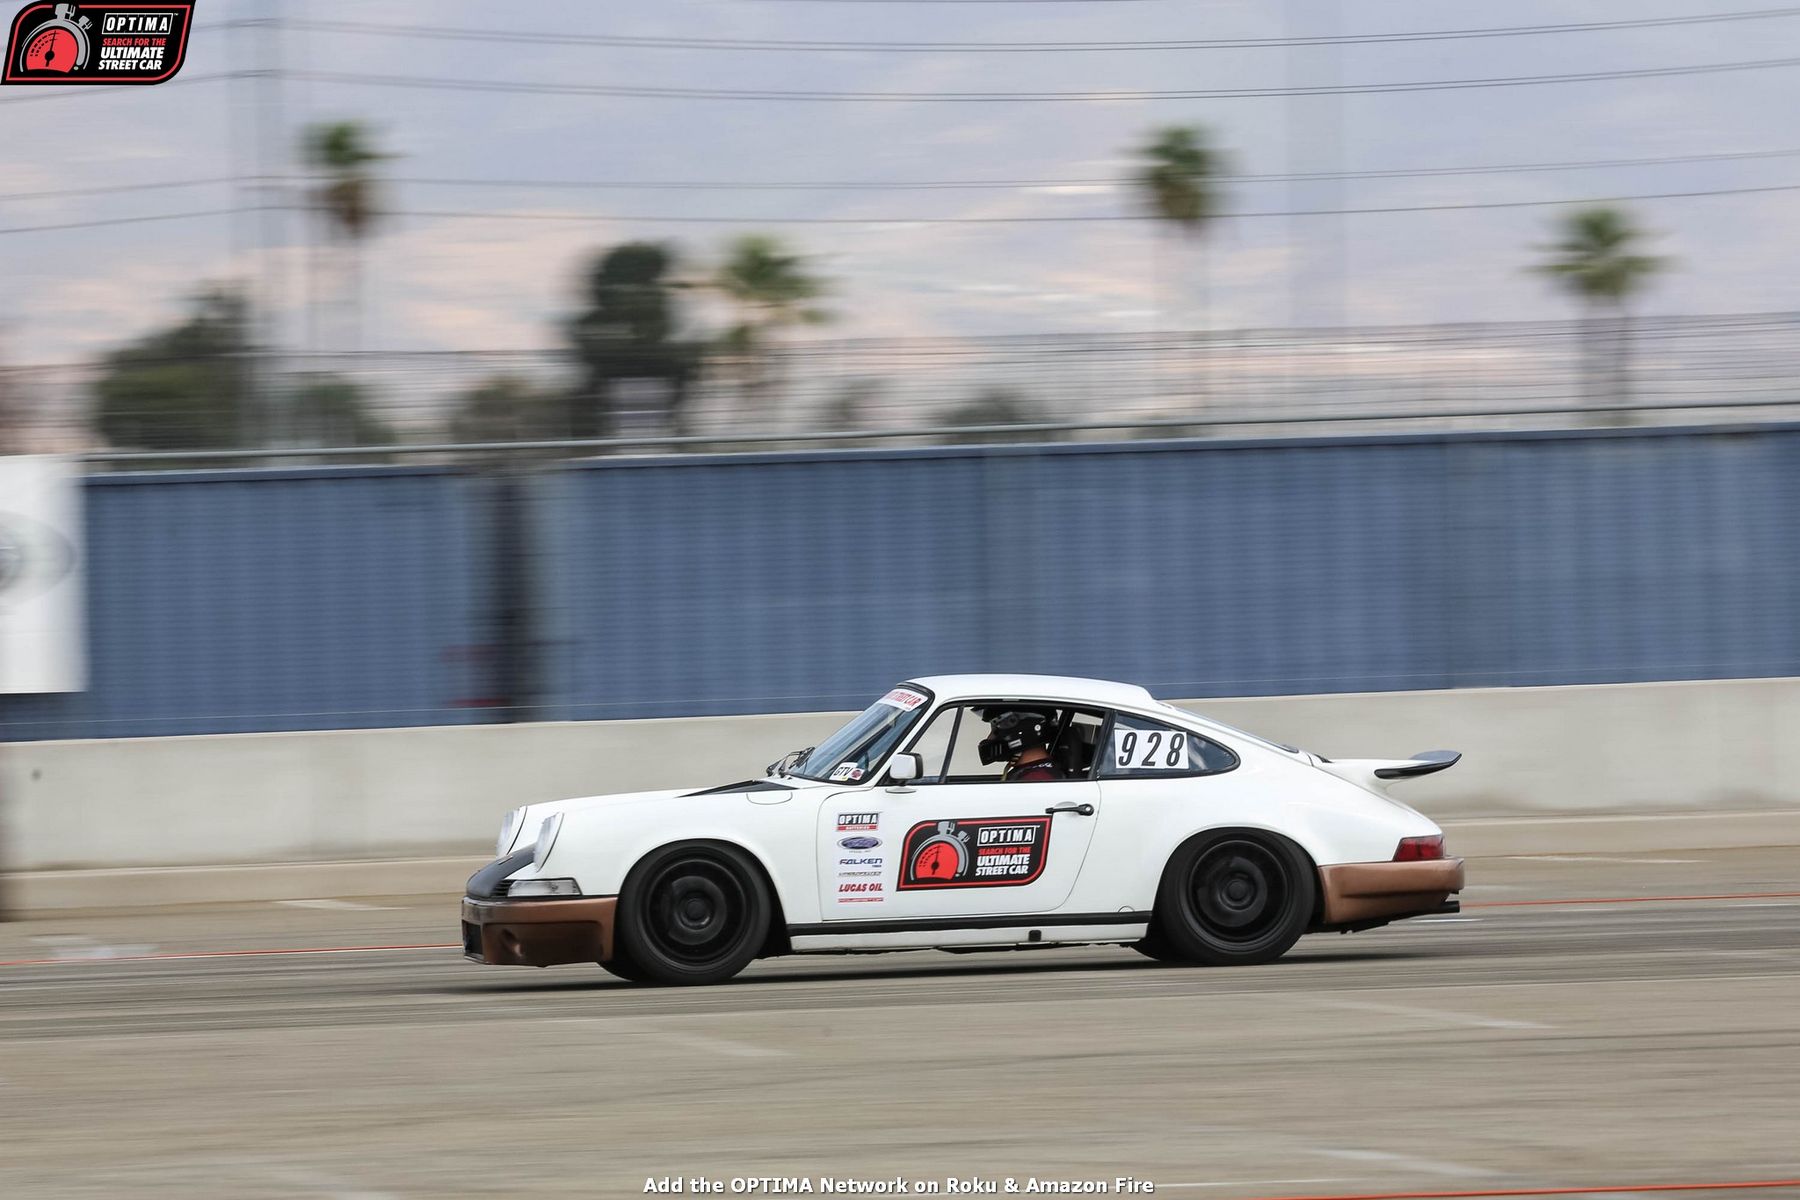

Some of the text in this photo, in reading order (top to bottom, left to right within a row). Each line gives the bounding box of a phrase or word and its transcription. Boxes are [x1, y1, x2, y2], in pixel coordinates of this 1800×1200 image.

[1118, 731, 1185, 767] 928
[833, 766, 854, 776] GTV
[839, 814, 878, 824] OPTIMA
[980, 828, 1032, 843] OPTIMA
[1004, 847, 1017, 855] FOR
[977, 854, 1030, 866] ULTIMATE
[975, 865, 1028, 876] STREET CAR
[838, 883, 883, 892] LUCAS OIL
